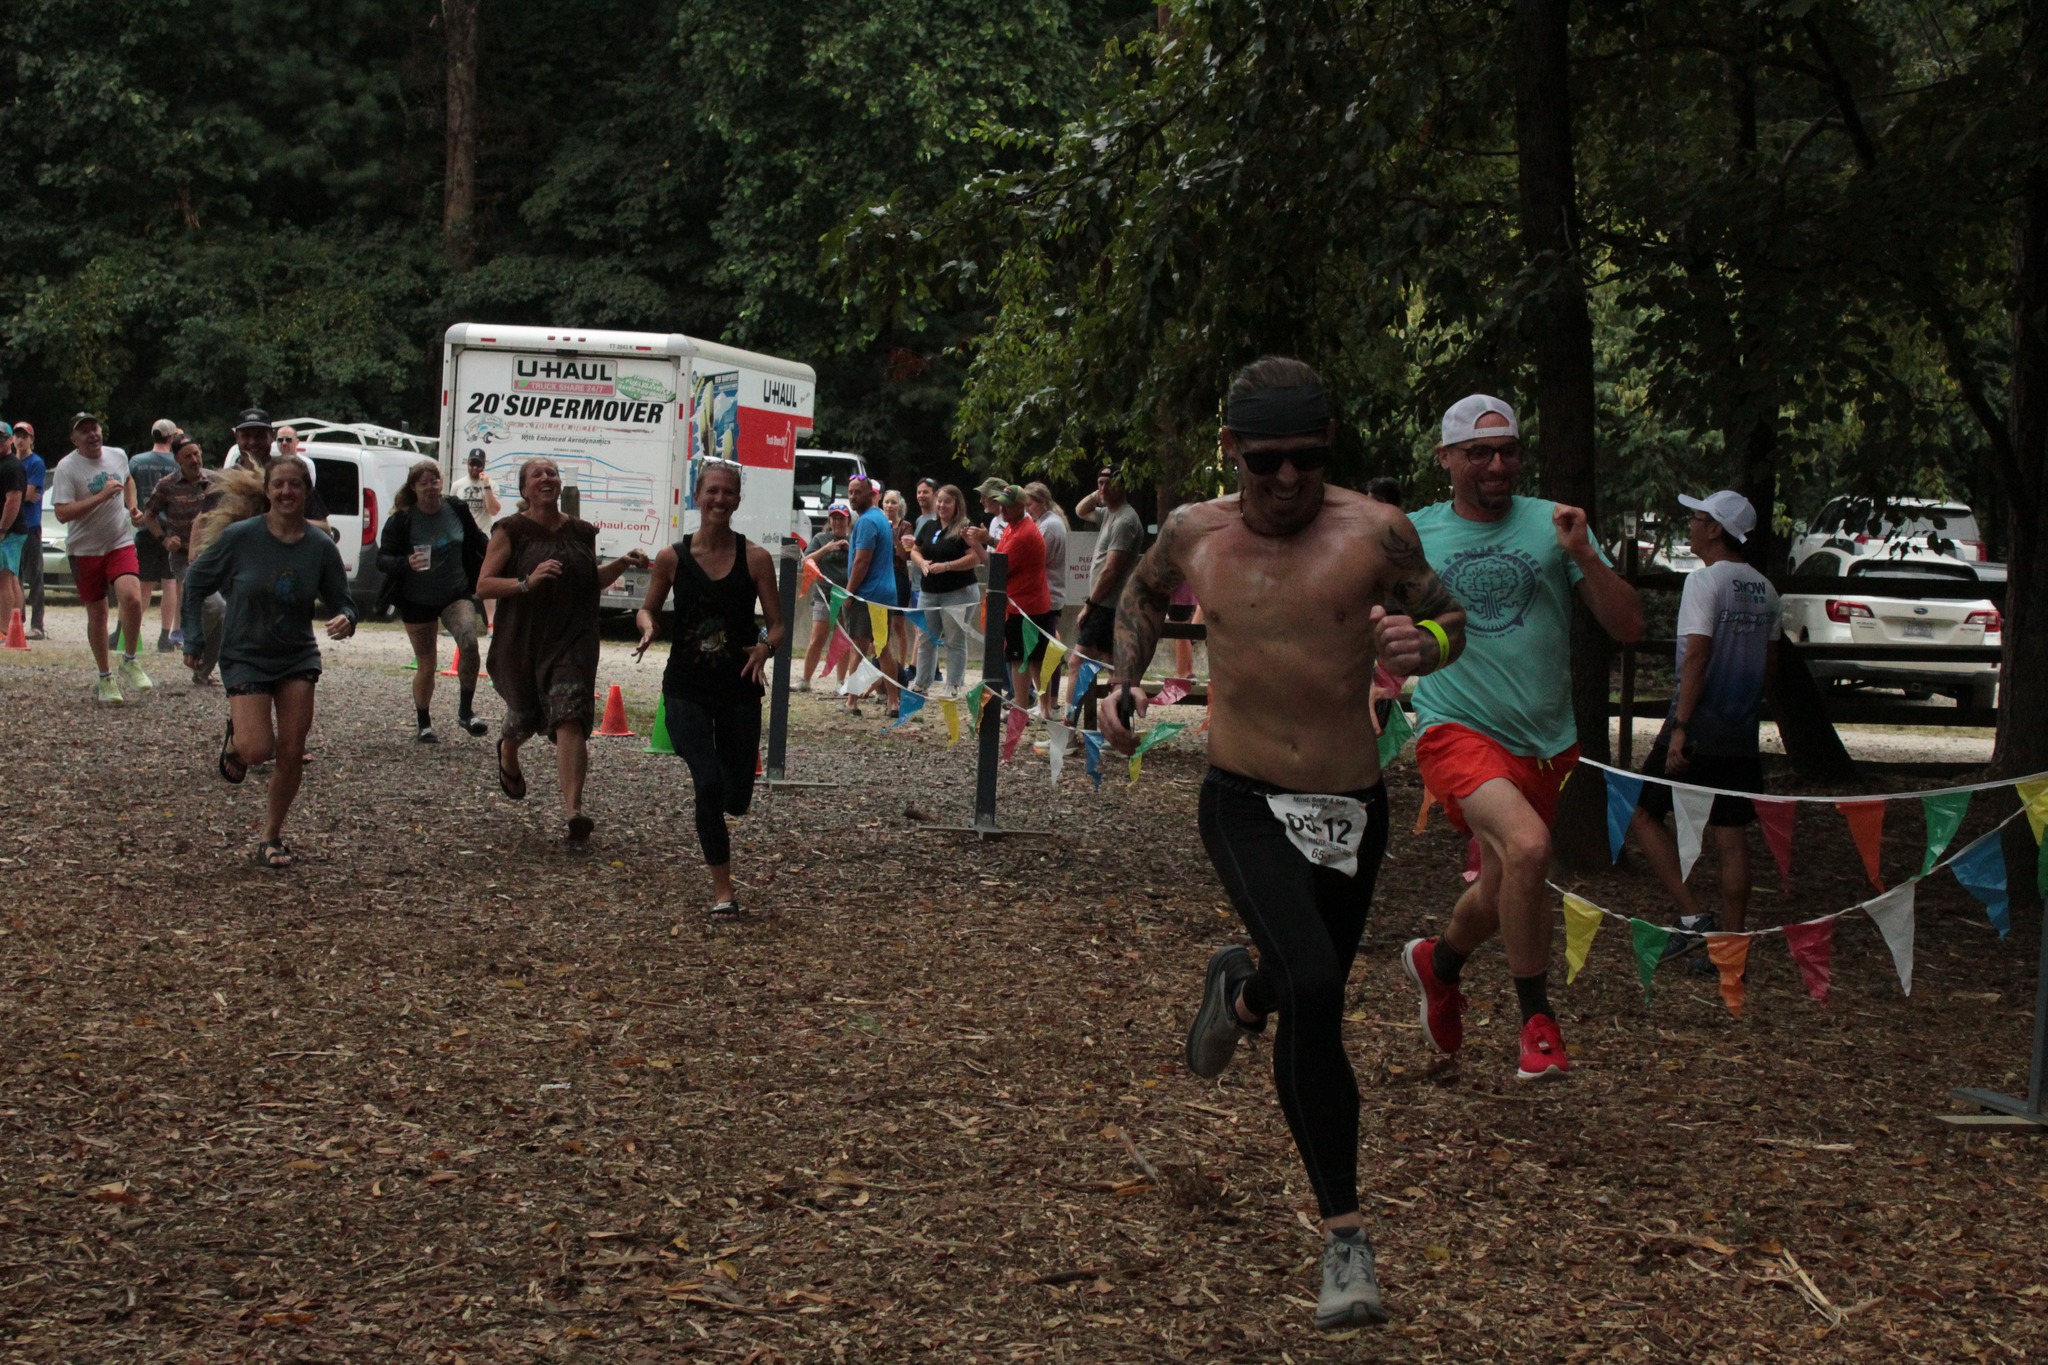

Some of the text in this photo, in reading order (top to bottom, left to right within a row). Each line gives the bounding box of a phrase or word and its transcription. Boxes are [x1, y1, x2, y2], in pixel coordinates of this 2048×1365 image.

[517, 360, 613, 381] U-HAUL
[531, 382, 604, 393] TRUCK SHARE 24/7
[763, 379, 797, 408] U-HAUL
[537, 435, 566, 443] Enhanced
[568, 437, 611, 446] Aerodynamics
[594, 521, 650, 531] uhaul.com
[1443, 544, 1544, 576] FAMILY TREE
[1732, 579, 1766, 596] SNOW
